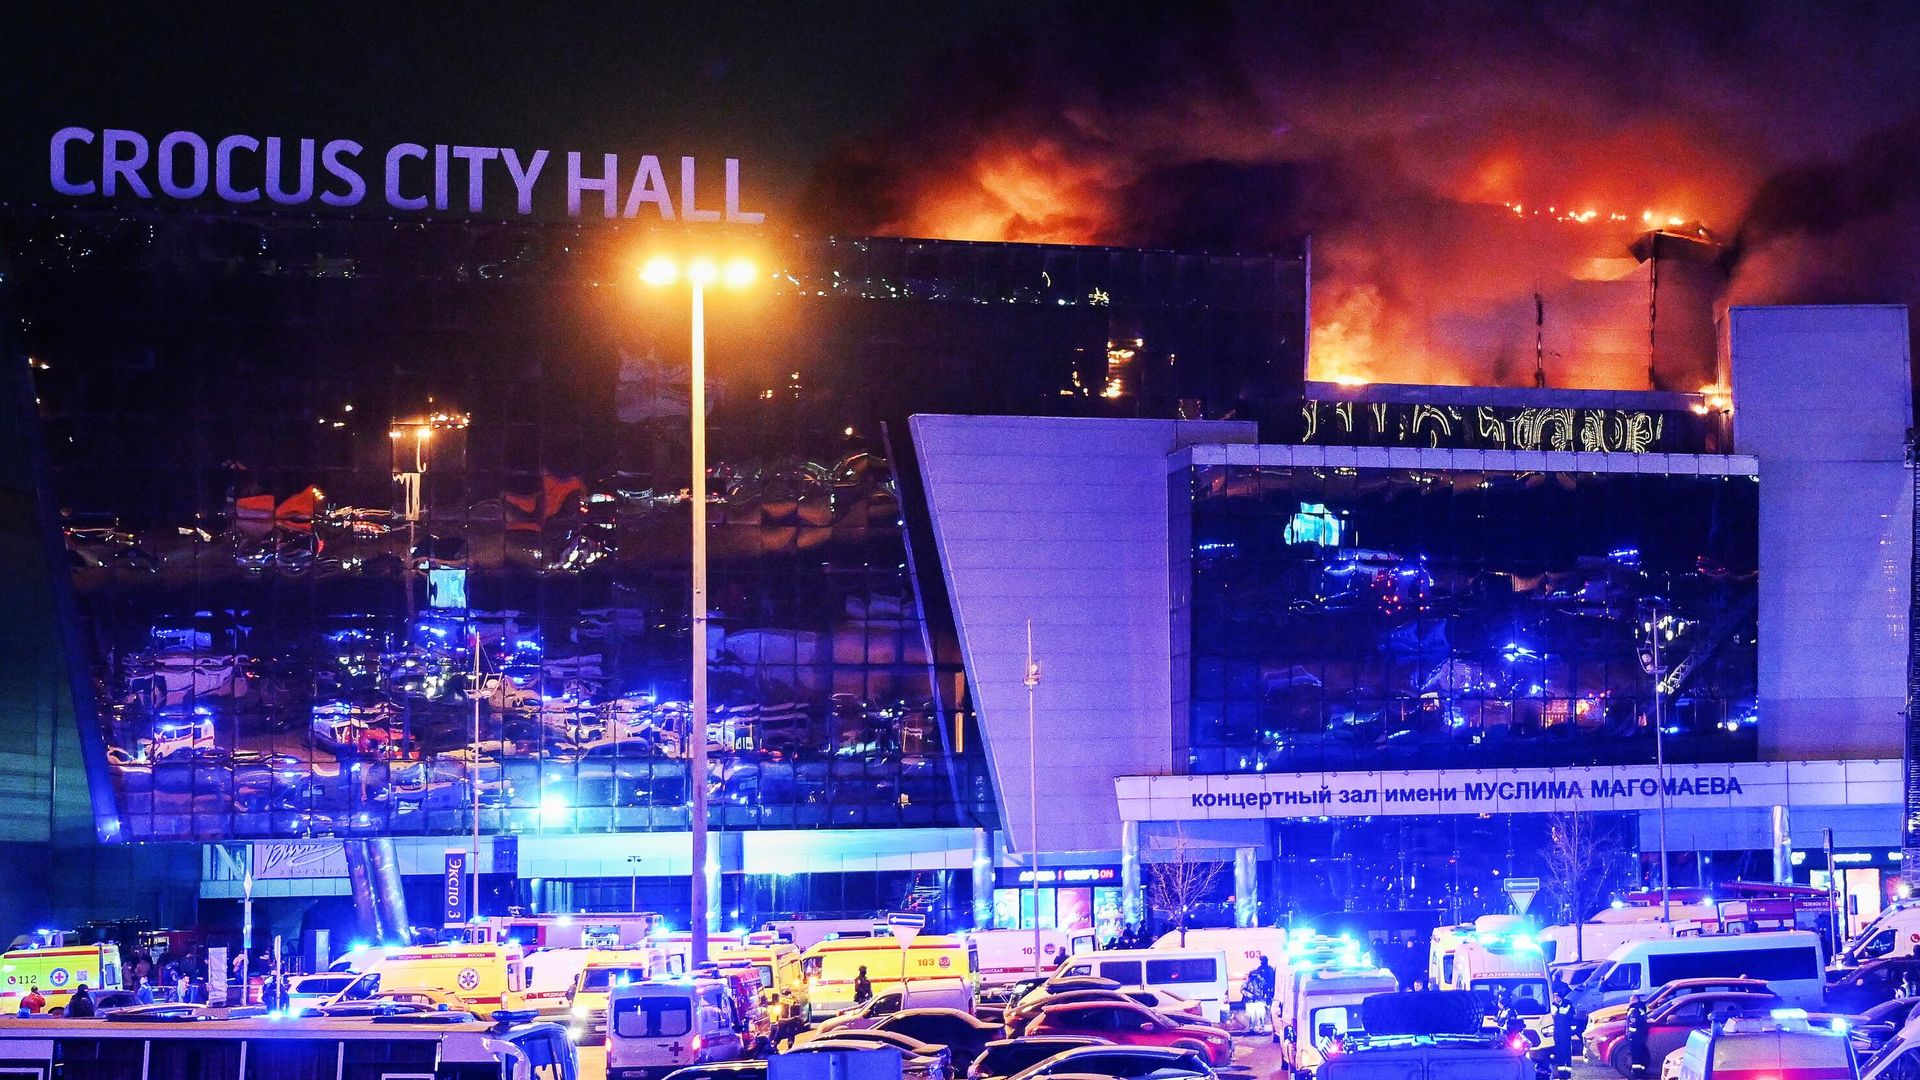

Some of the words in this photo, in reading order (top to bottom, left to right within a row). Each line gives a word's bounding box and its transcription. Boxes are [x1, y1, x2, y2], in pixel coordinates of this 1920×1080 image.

[50, 127, 367, 206] CROCUS
[385, 143, 549, 214] CITY
[567, 152, 765, 224] HALL
[1192, 785, 1331, 810] концертный
[1339, 789, 1376, 803] зал
[1385, 787, 1456, 802] имени
[1465, 780, 1584, 801] МУСЛИМА
[1591, 777, 1743, 798] МАГОМАЕВА
[448, 858, 462, 906] Экспо
[1099, 869, 1114, 879] ON
[918, 958, 935, 967] 103
[19, 975, 37, 985] 112
